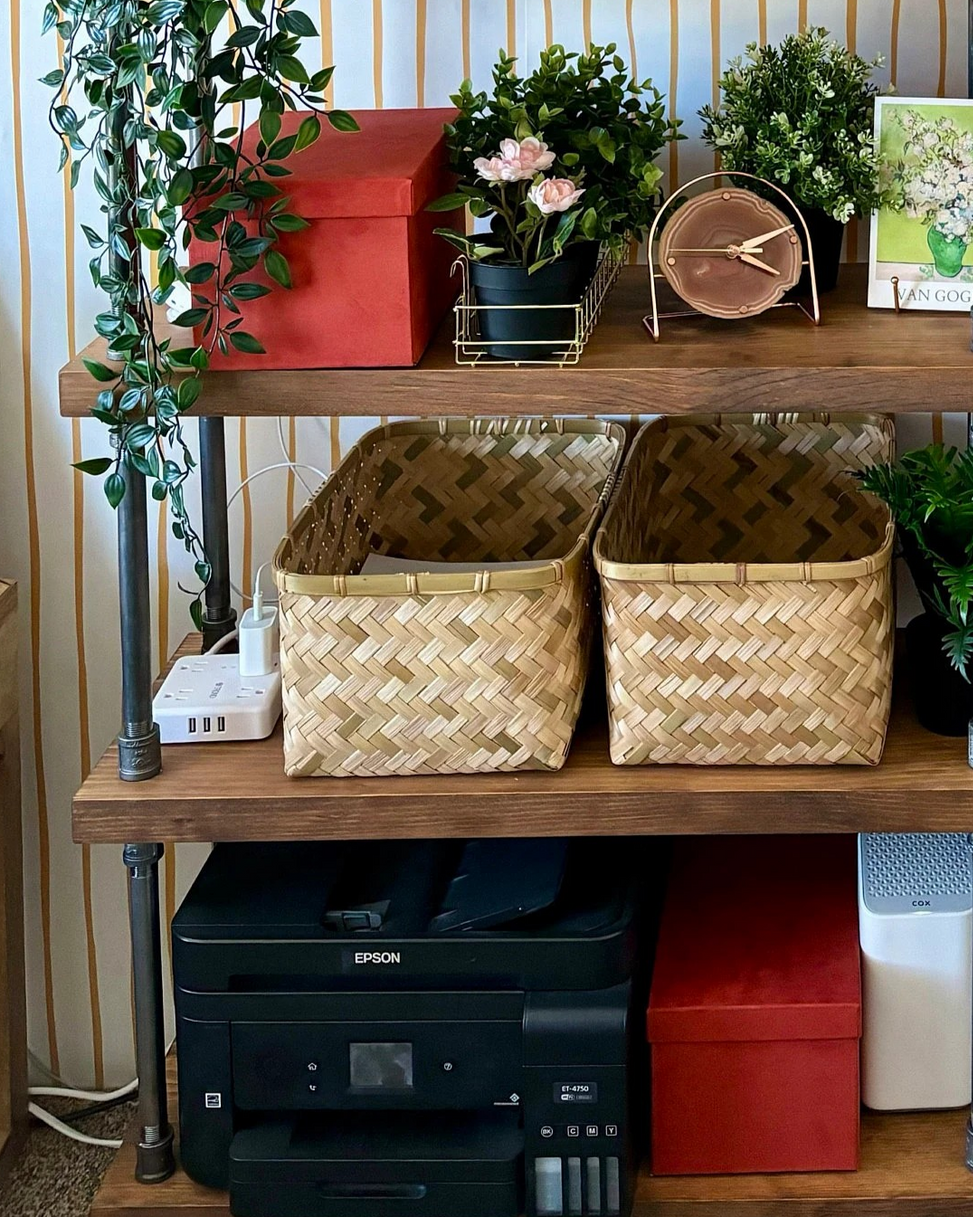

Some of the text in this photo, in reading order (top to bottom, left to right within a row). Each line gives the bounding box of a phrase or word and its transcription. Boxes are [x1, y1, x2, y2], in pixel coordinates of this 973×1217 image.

[897, 288, 930, 301] VAN
[354, 951, 401, 964] EPSON
[561, 1085, 589, 1093] ET-4750
